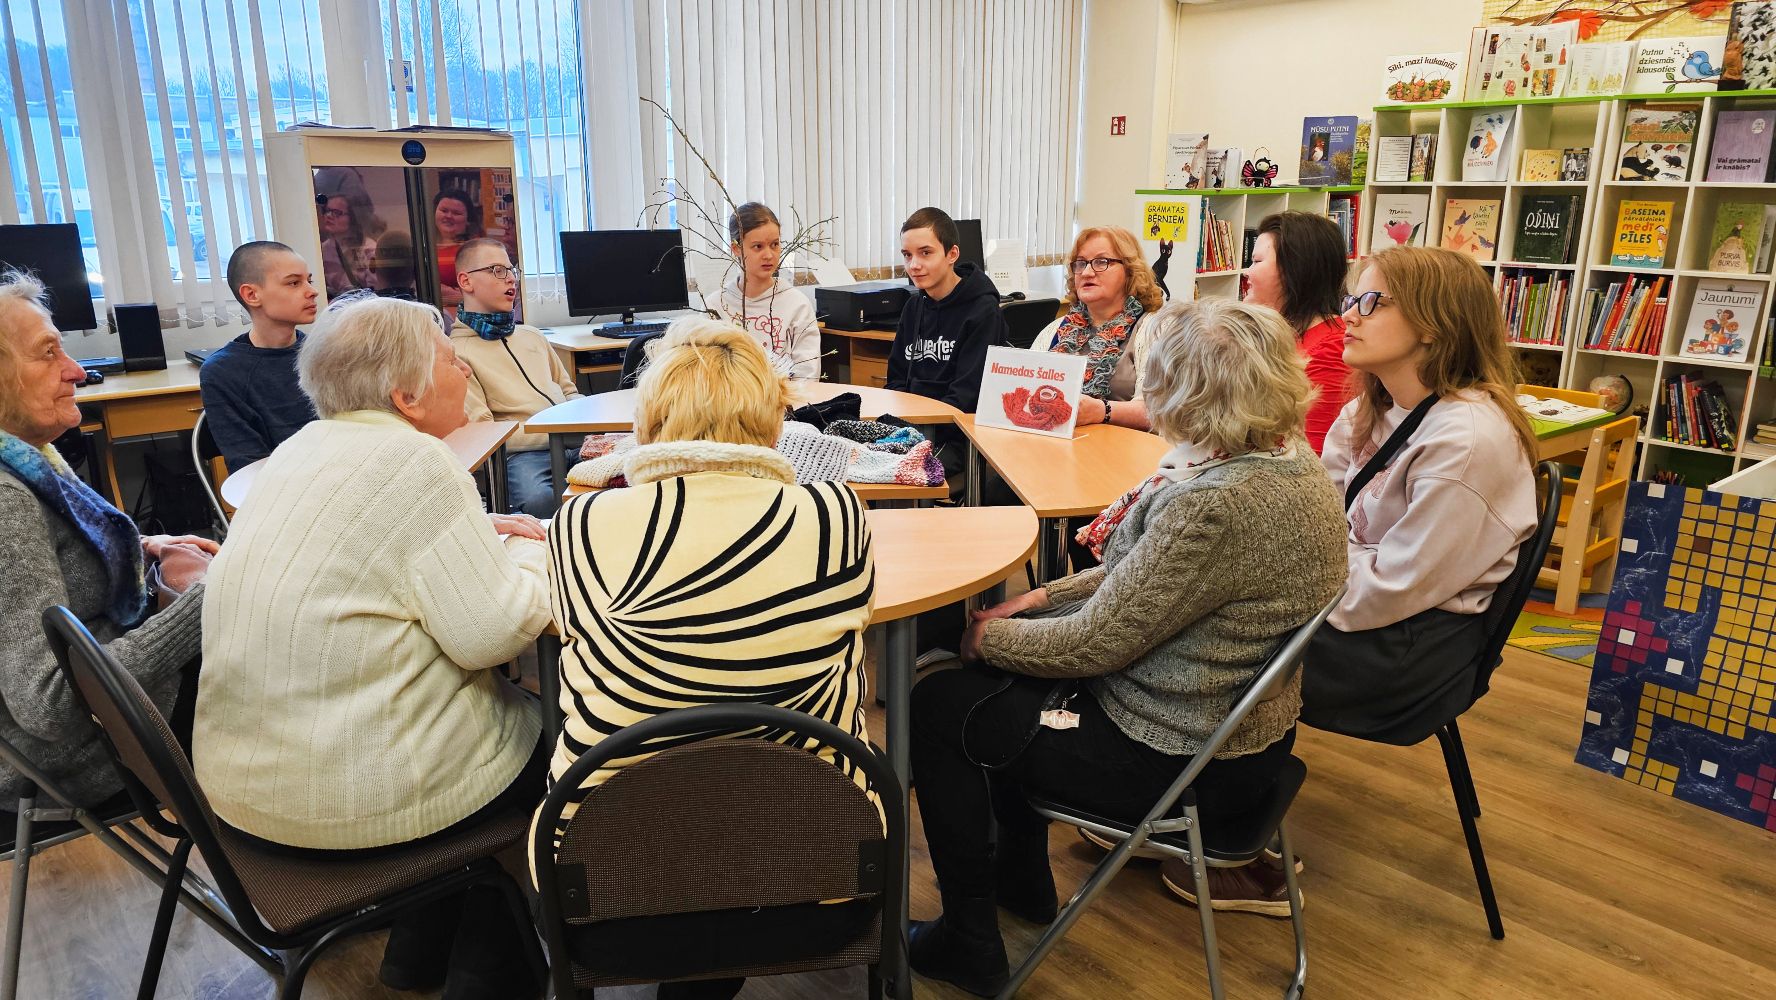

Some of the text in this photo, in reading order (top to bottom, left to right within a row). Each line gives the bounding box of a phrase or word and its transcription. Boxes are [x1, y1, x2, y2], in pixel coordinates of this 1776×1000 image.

[1405, 56, 1424, 67] mazi
[1636, 66, 1676, 74] klausoties
[1147, 204, 1185, 214] GRĀMATAS
[1624, 207, 1666, 216] BASEINA
[1147, 213, 1185, 225] BĒRNIEM
[1622, 222, 1654, 232] medī
[1619, 230, 1652, 244] PĪLES
[1720, 252, 1740, 260] PURVA
[1718, 259, 1741, 268] BURVIS
[1700, 291, 1756, 305] Jaunumi
[991, 362, 1066, 382] Namedas šalles
